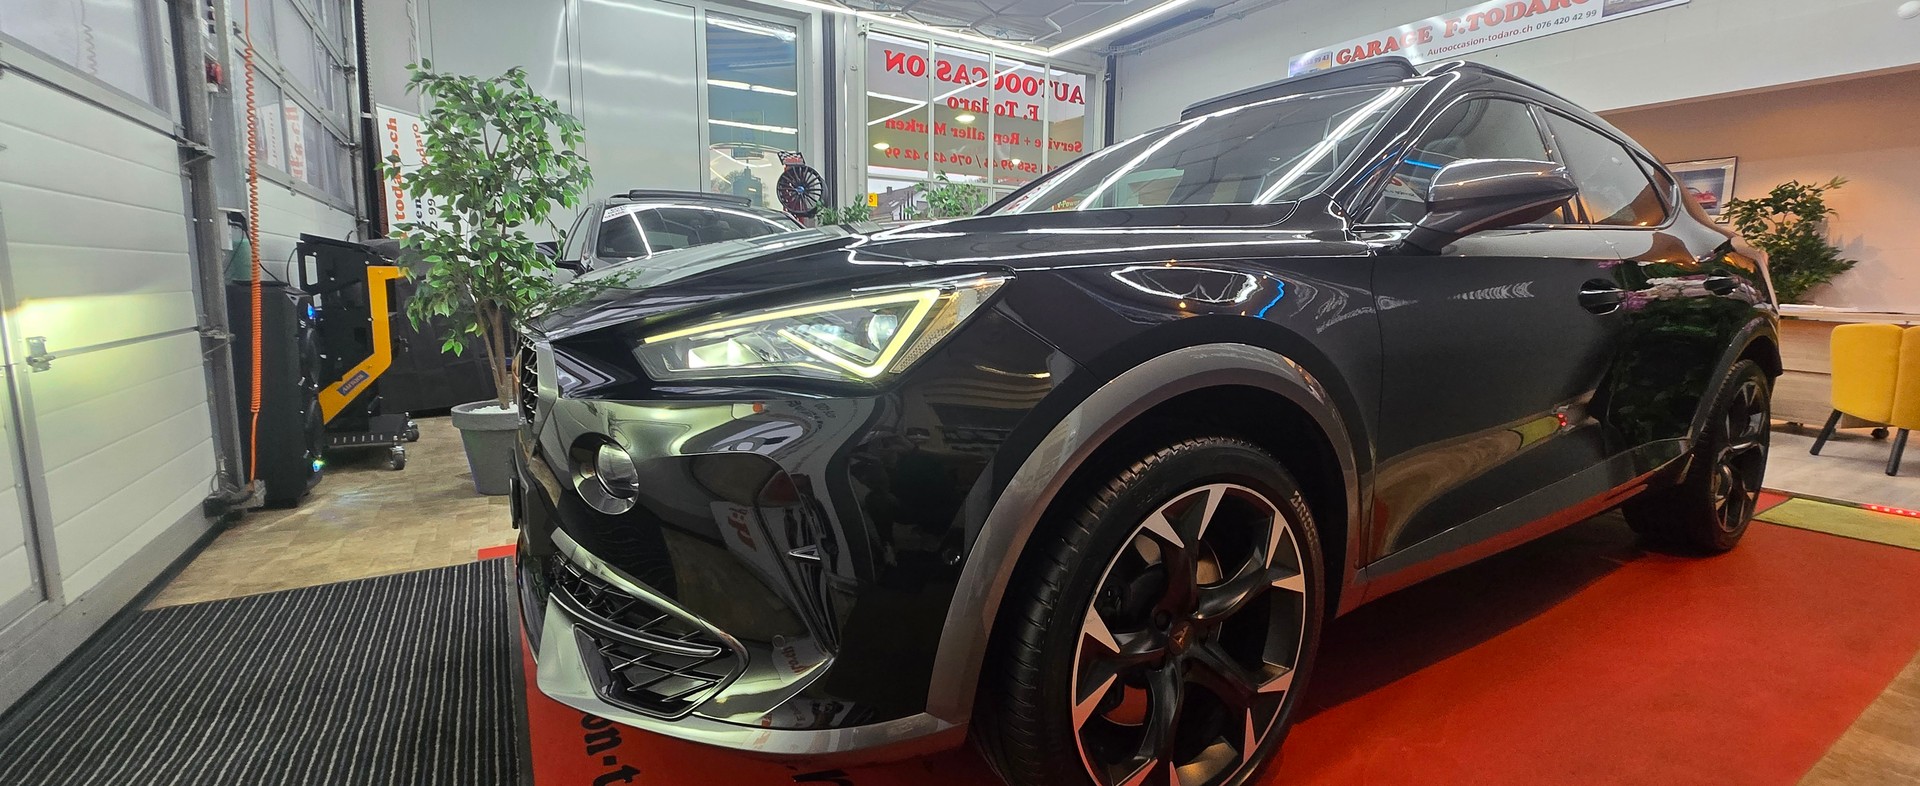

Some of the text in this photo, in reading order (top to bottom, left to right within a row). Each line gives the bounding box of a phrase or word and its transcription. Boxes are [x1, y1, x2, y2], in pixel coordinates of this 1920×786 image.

[1335, 25, 1434, 65] GARAGE
[1426, 23, 1533, 57] Autooccasion-todaro.ch
[1535, 20, 1552, 30] 076
[1553, 16, 1570, 26] 420
[1571, 12, 1584, 21] 42
[1585, 9, 1597, 19] 99
